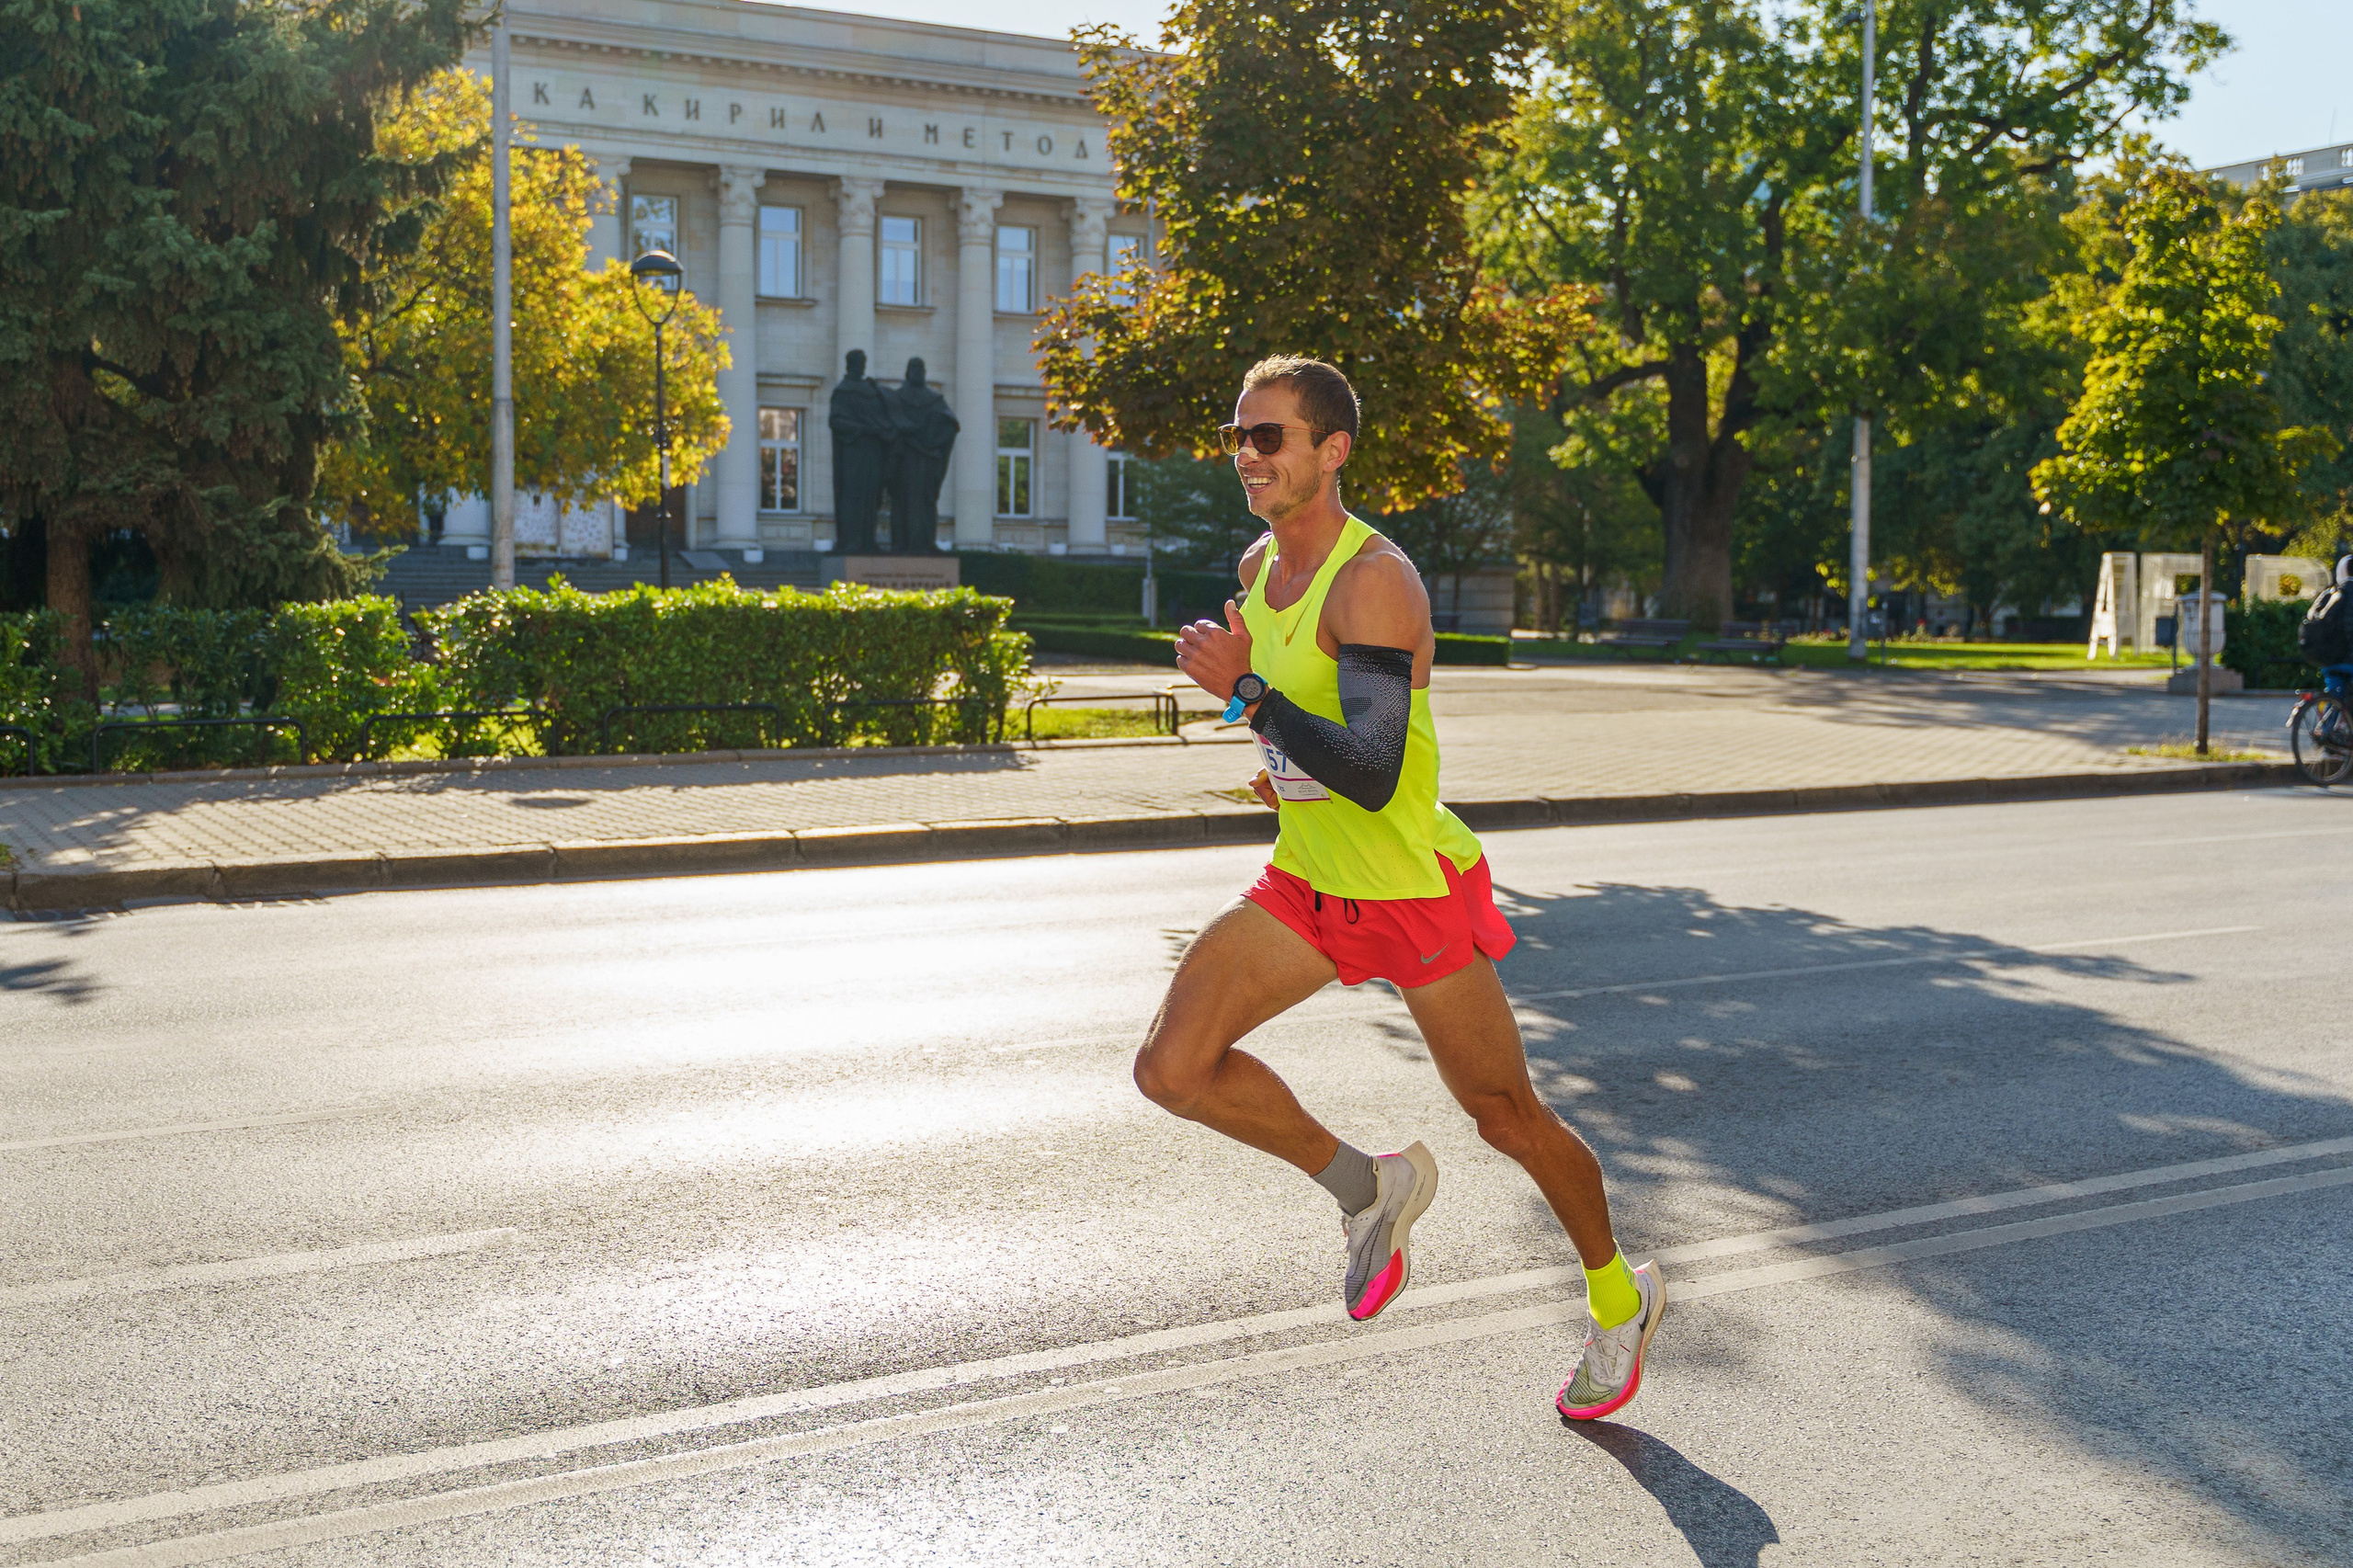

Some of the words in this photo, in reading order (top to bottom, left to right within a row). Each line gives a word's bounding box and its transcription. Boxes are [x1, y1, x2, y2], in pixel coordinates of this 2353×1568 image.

[642, 93, 826, 133] КИРИЛ
[868, 118, 883, 139] И
[924, 123, 1089, 160] МЕТОД
[1263, 746, 1287, 773] 57
